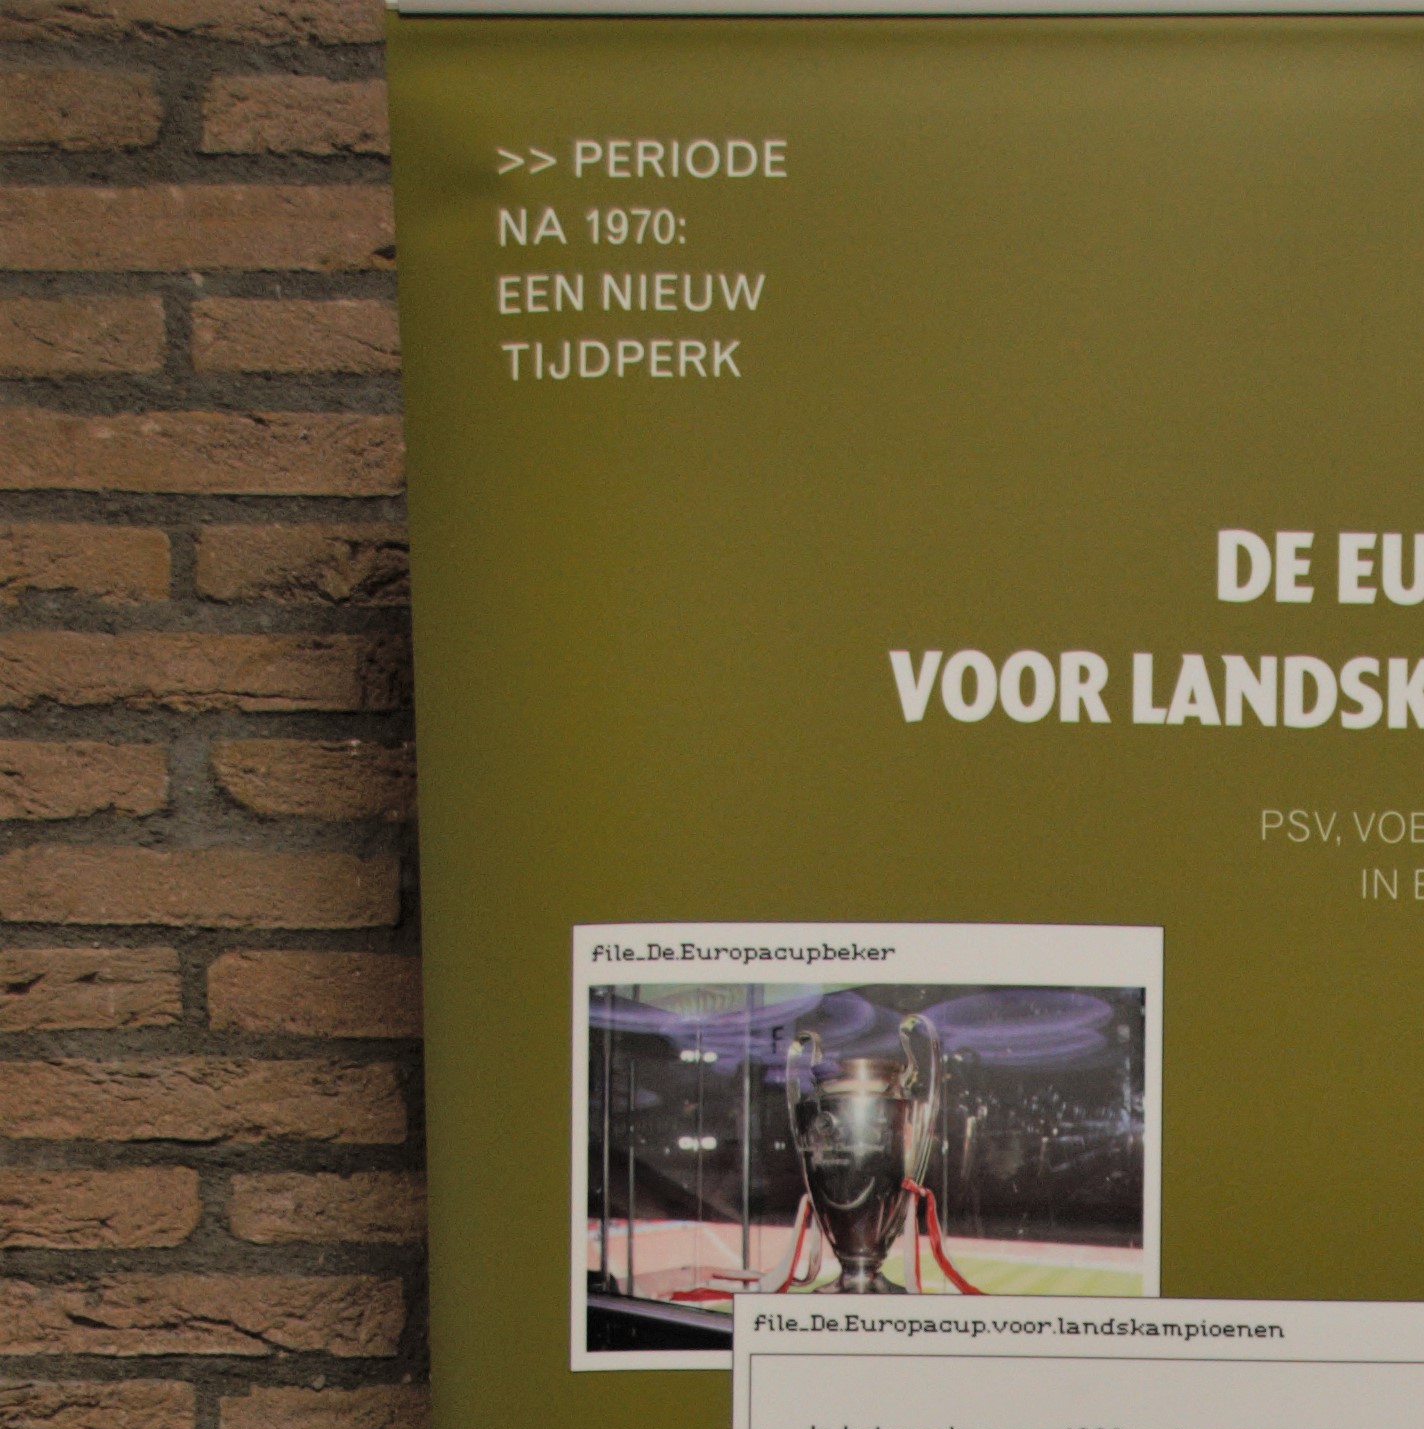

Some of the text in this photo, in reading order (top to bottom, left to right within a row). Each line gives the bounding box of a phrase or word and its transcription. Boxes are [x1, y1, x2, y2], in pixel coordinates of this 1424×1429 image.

[575, 139, 787, 179] PERIODE
[499, 207, 686, 246] NA 1970:
[499, 273, 765, 314] EEN NIEUW
[502, 339, 741, 381] TIJDPERK
[1217, 528, 1314, 603] DE
[889, 649, 1111, 723] VOOR
[1261, 809, 1341, 846] PSV,
[1362, 868, 1398, 900] IN
